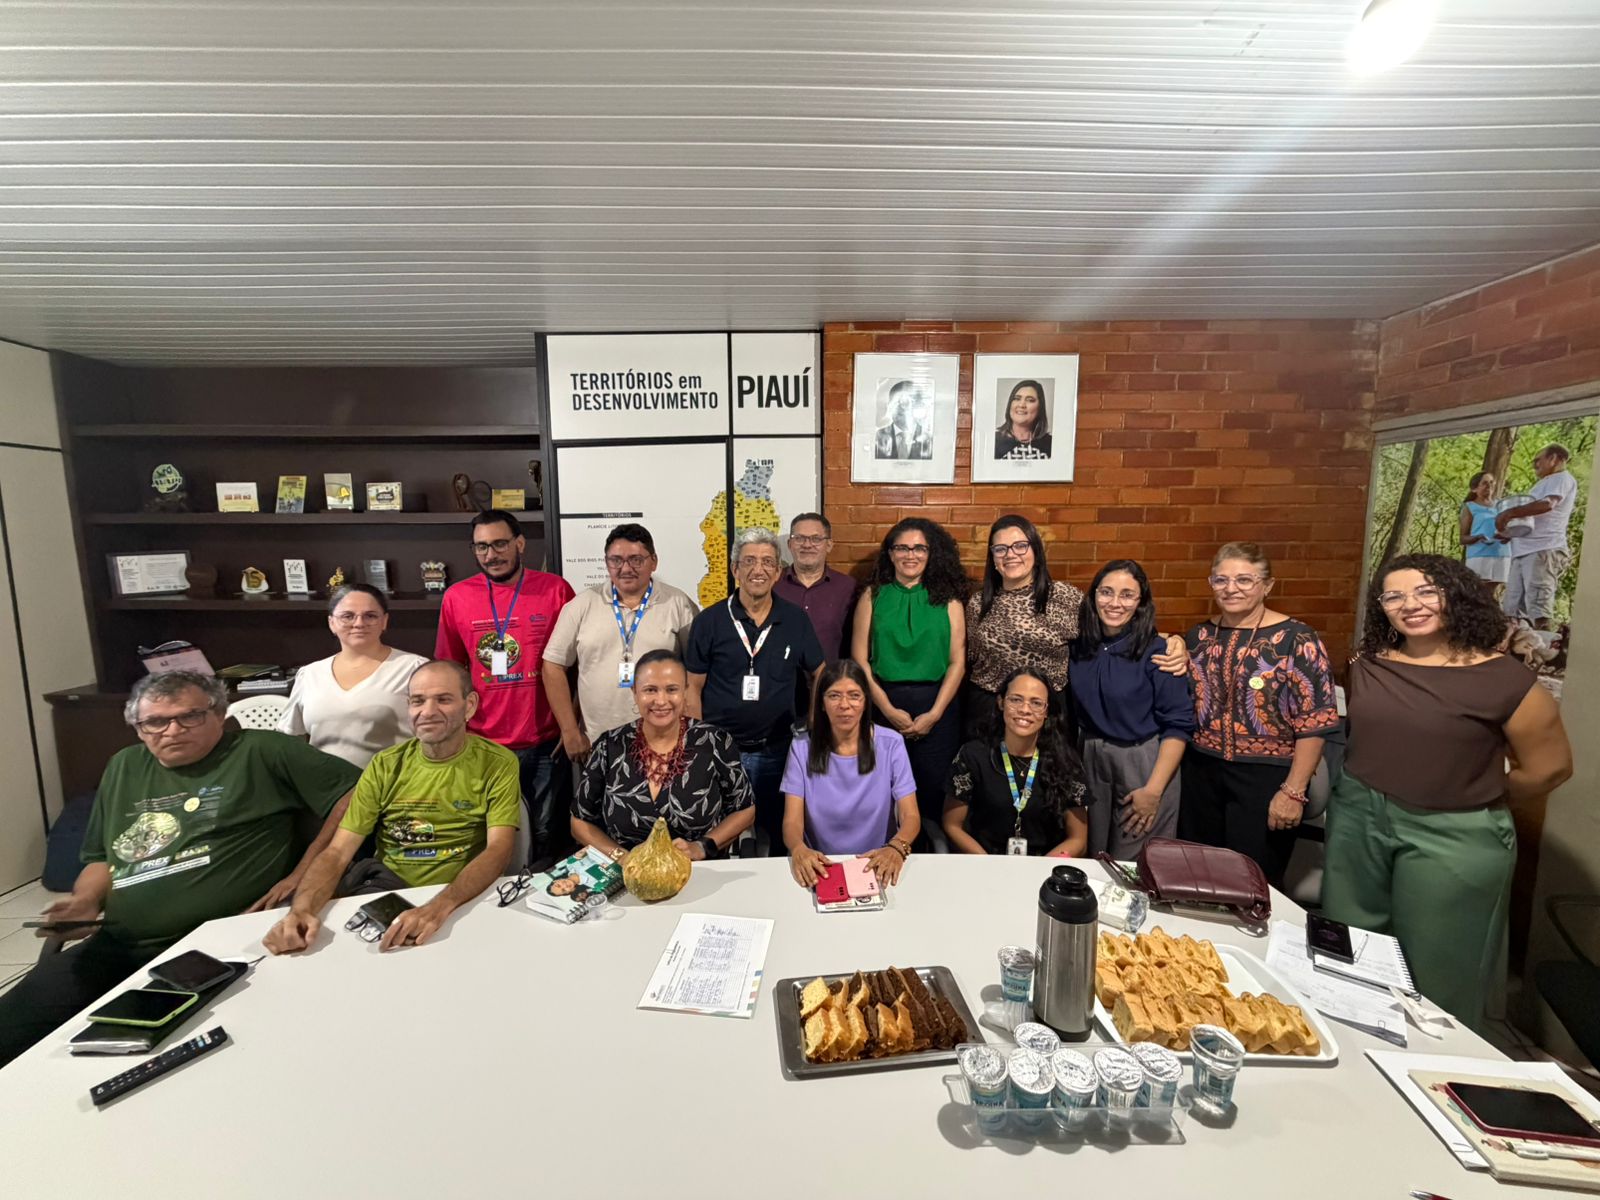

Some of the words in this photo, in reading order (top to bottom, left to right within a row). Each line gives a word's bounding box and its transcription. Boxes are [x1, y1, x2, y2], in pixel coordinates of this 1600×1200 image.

[570, 368, 673, 390] TERRITÓRIOS
[679, 375, 702, 389] em
[737, 366, 812, 408] PIAUÍ
[572, 392, 718, 411] DESENVOLVIMENTO
